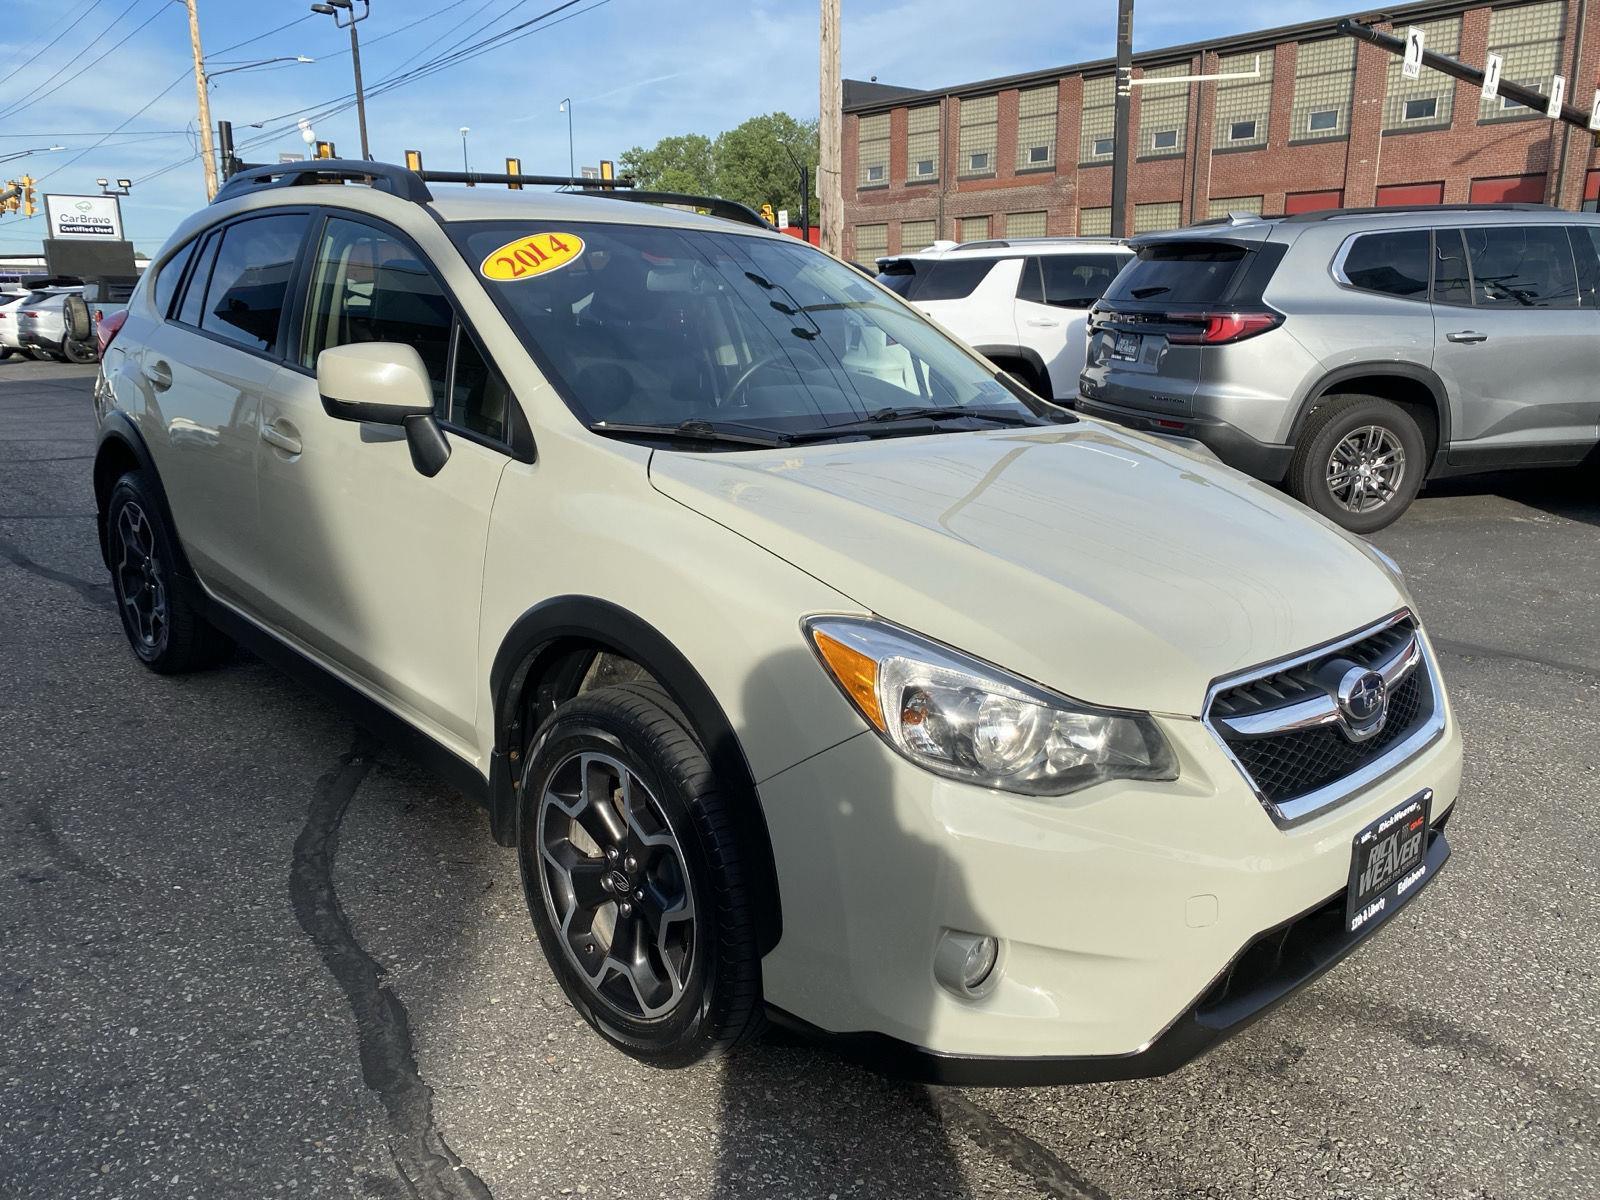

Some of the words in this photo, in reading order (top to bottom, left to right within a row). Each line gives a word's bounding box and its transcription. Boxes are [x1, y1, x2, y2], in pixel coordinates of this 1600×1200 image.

[60, 213, 111, 224] CarBravo
[61, 225, 94, 233] Certified
[496, 234, 571, 277] 2014
[1359, 831, 1422, 897] WEAVER
[1368, 830, 1400, 869] RICK
[1397, 865, 1426, 896] Edinboro
